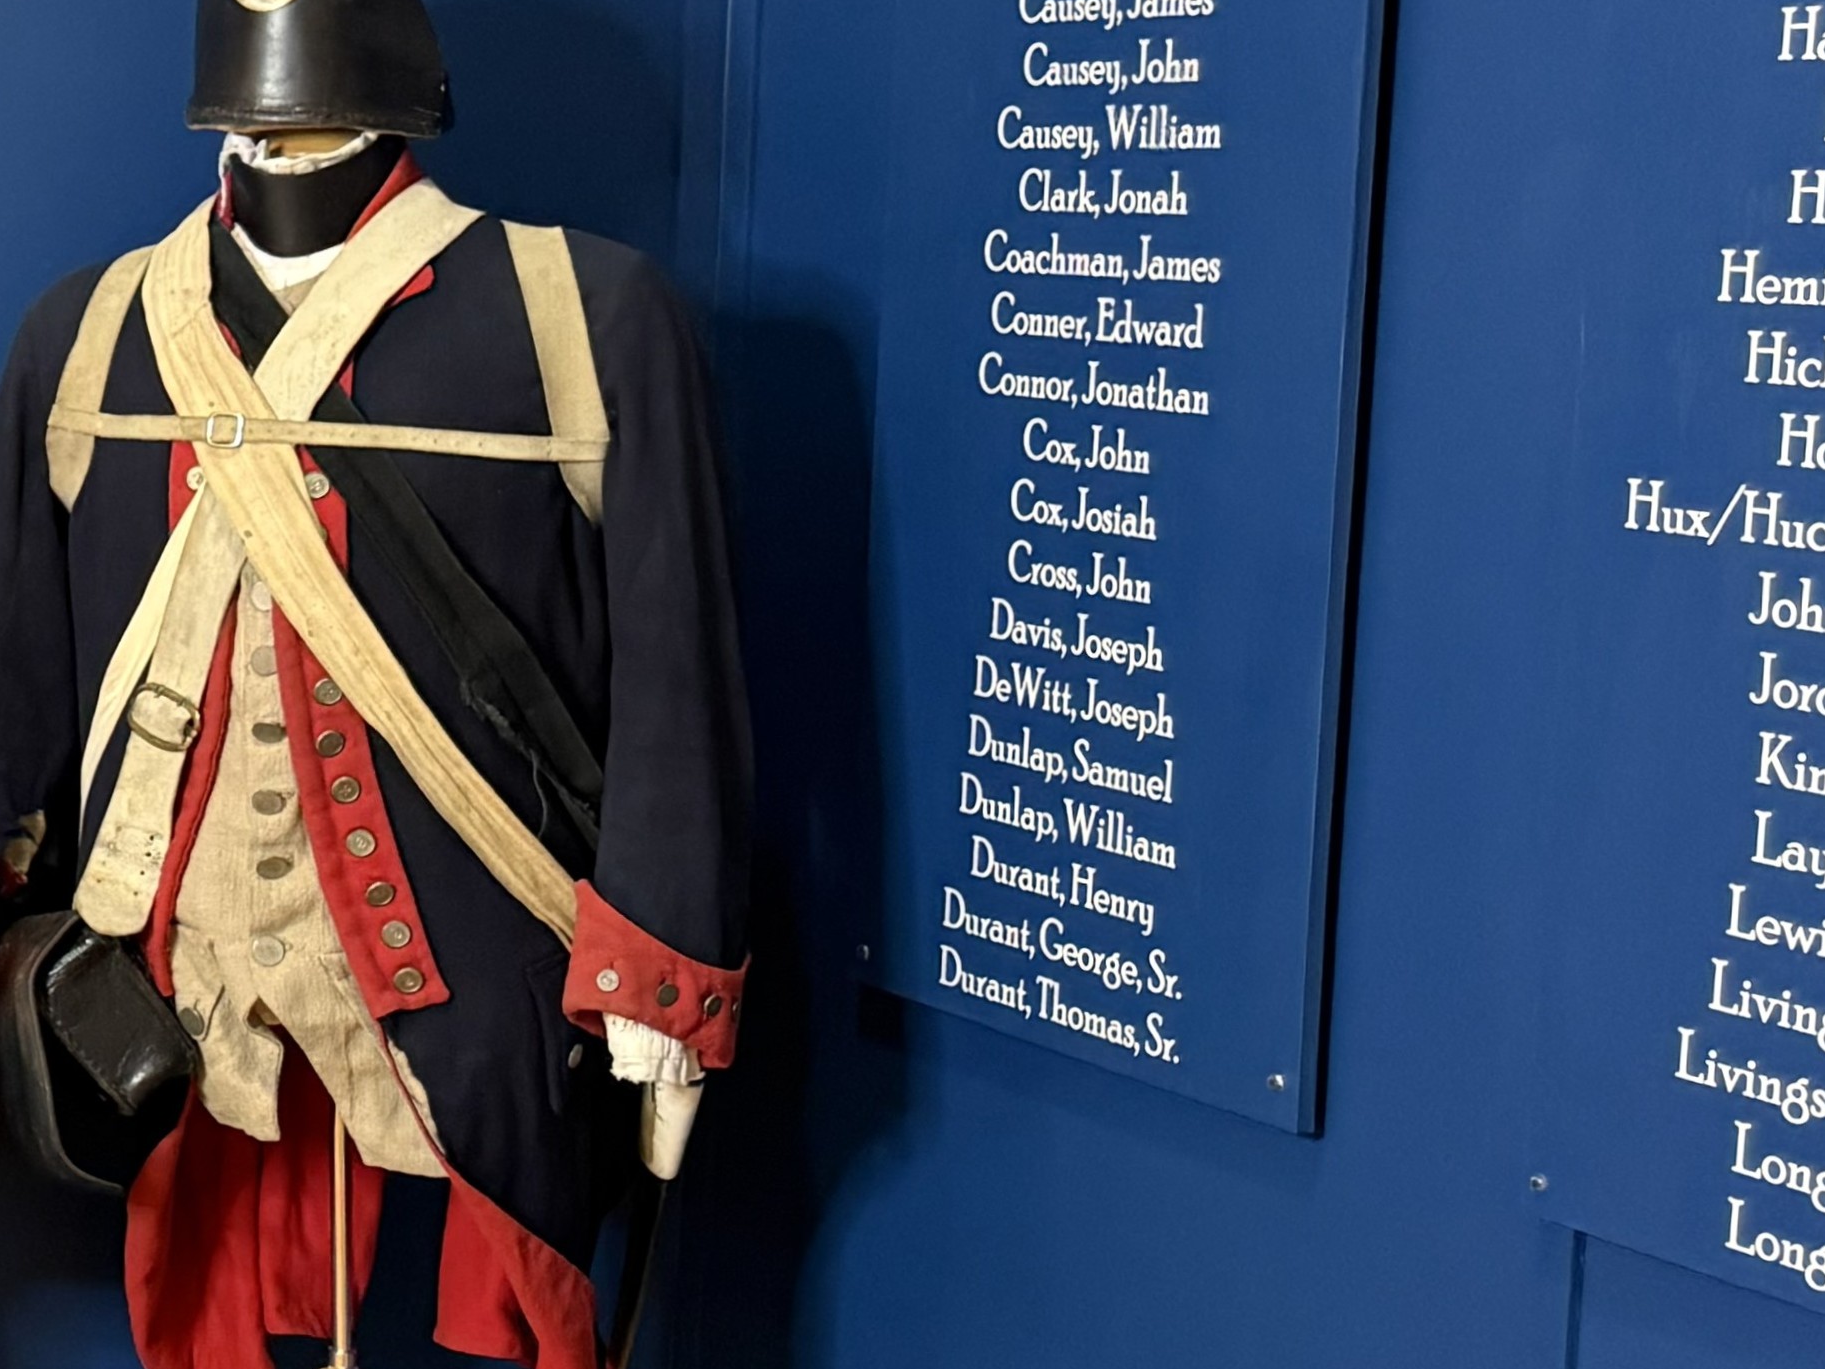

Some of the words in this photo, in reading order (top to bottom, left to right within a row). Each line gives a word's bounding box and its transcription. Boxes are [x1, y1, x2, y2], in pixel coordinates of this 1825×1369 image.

[1023, 41, 1128, 95] Causey,
[1131, 38, 1200, 85] John
[997, 105, 1100, 160] Causey,
[1105, 103, 1222, 150] William
[1018, 167, 1101, 220] Clark,
[1103, 169, 1188, 216] Jonah
[984, 228, 1130, 285] Coachman,
[1132, 234, 1221, 284] James
[991, 290, 1092, 347] Conner,
[1094, 296, 1204, 349] Edward
[978, 351, 1078, 409] Connor,
[1081, 360, 1209, 416] Jonathan
[1023, 417, 1082, 473] Cox,
[1084, 424, 1150, 475] John
[1010, 478, 1069, 533] Cox,
[1071, 486, 1157, 541] Josiah
[1008, 539, 1083, 599] Cross,
[1085, 551, 1151, 604] John
[989, 597, 1068, 659] Davis,
[1070, 612, 1164, 676] Joseph
[973, 654, 1077, 723] DeWitt,
[1080, 677, 1175, 742] Joseph
[968, 714, 1069, 784] Dunlap,
[1071, 738, 1173, 804] Samuel
[959, 771, 1059, 843] Dunlap,
[1063, 797, 1176, 870] William
[970, 835, 1066, 907] Durant,
[1069, 862, 1155, 937] Henry
[942, 886, 1036, 960] Durant,
[1039, 917, 1143, 994] George,
[1147, 948, 1183, 1000] Sr.
[939, 944, 1032, 1020] Durant,
[1035, 975, 1141, 1057] Thomas,
[1144, 1012, 1180, 1064] Sr.
